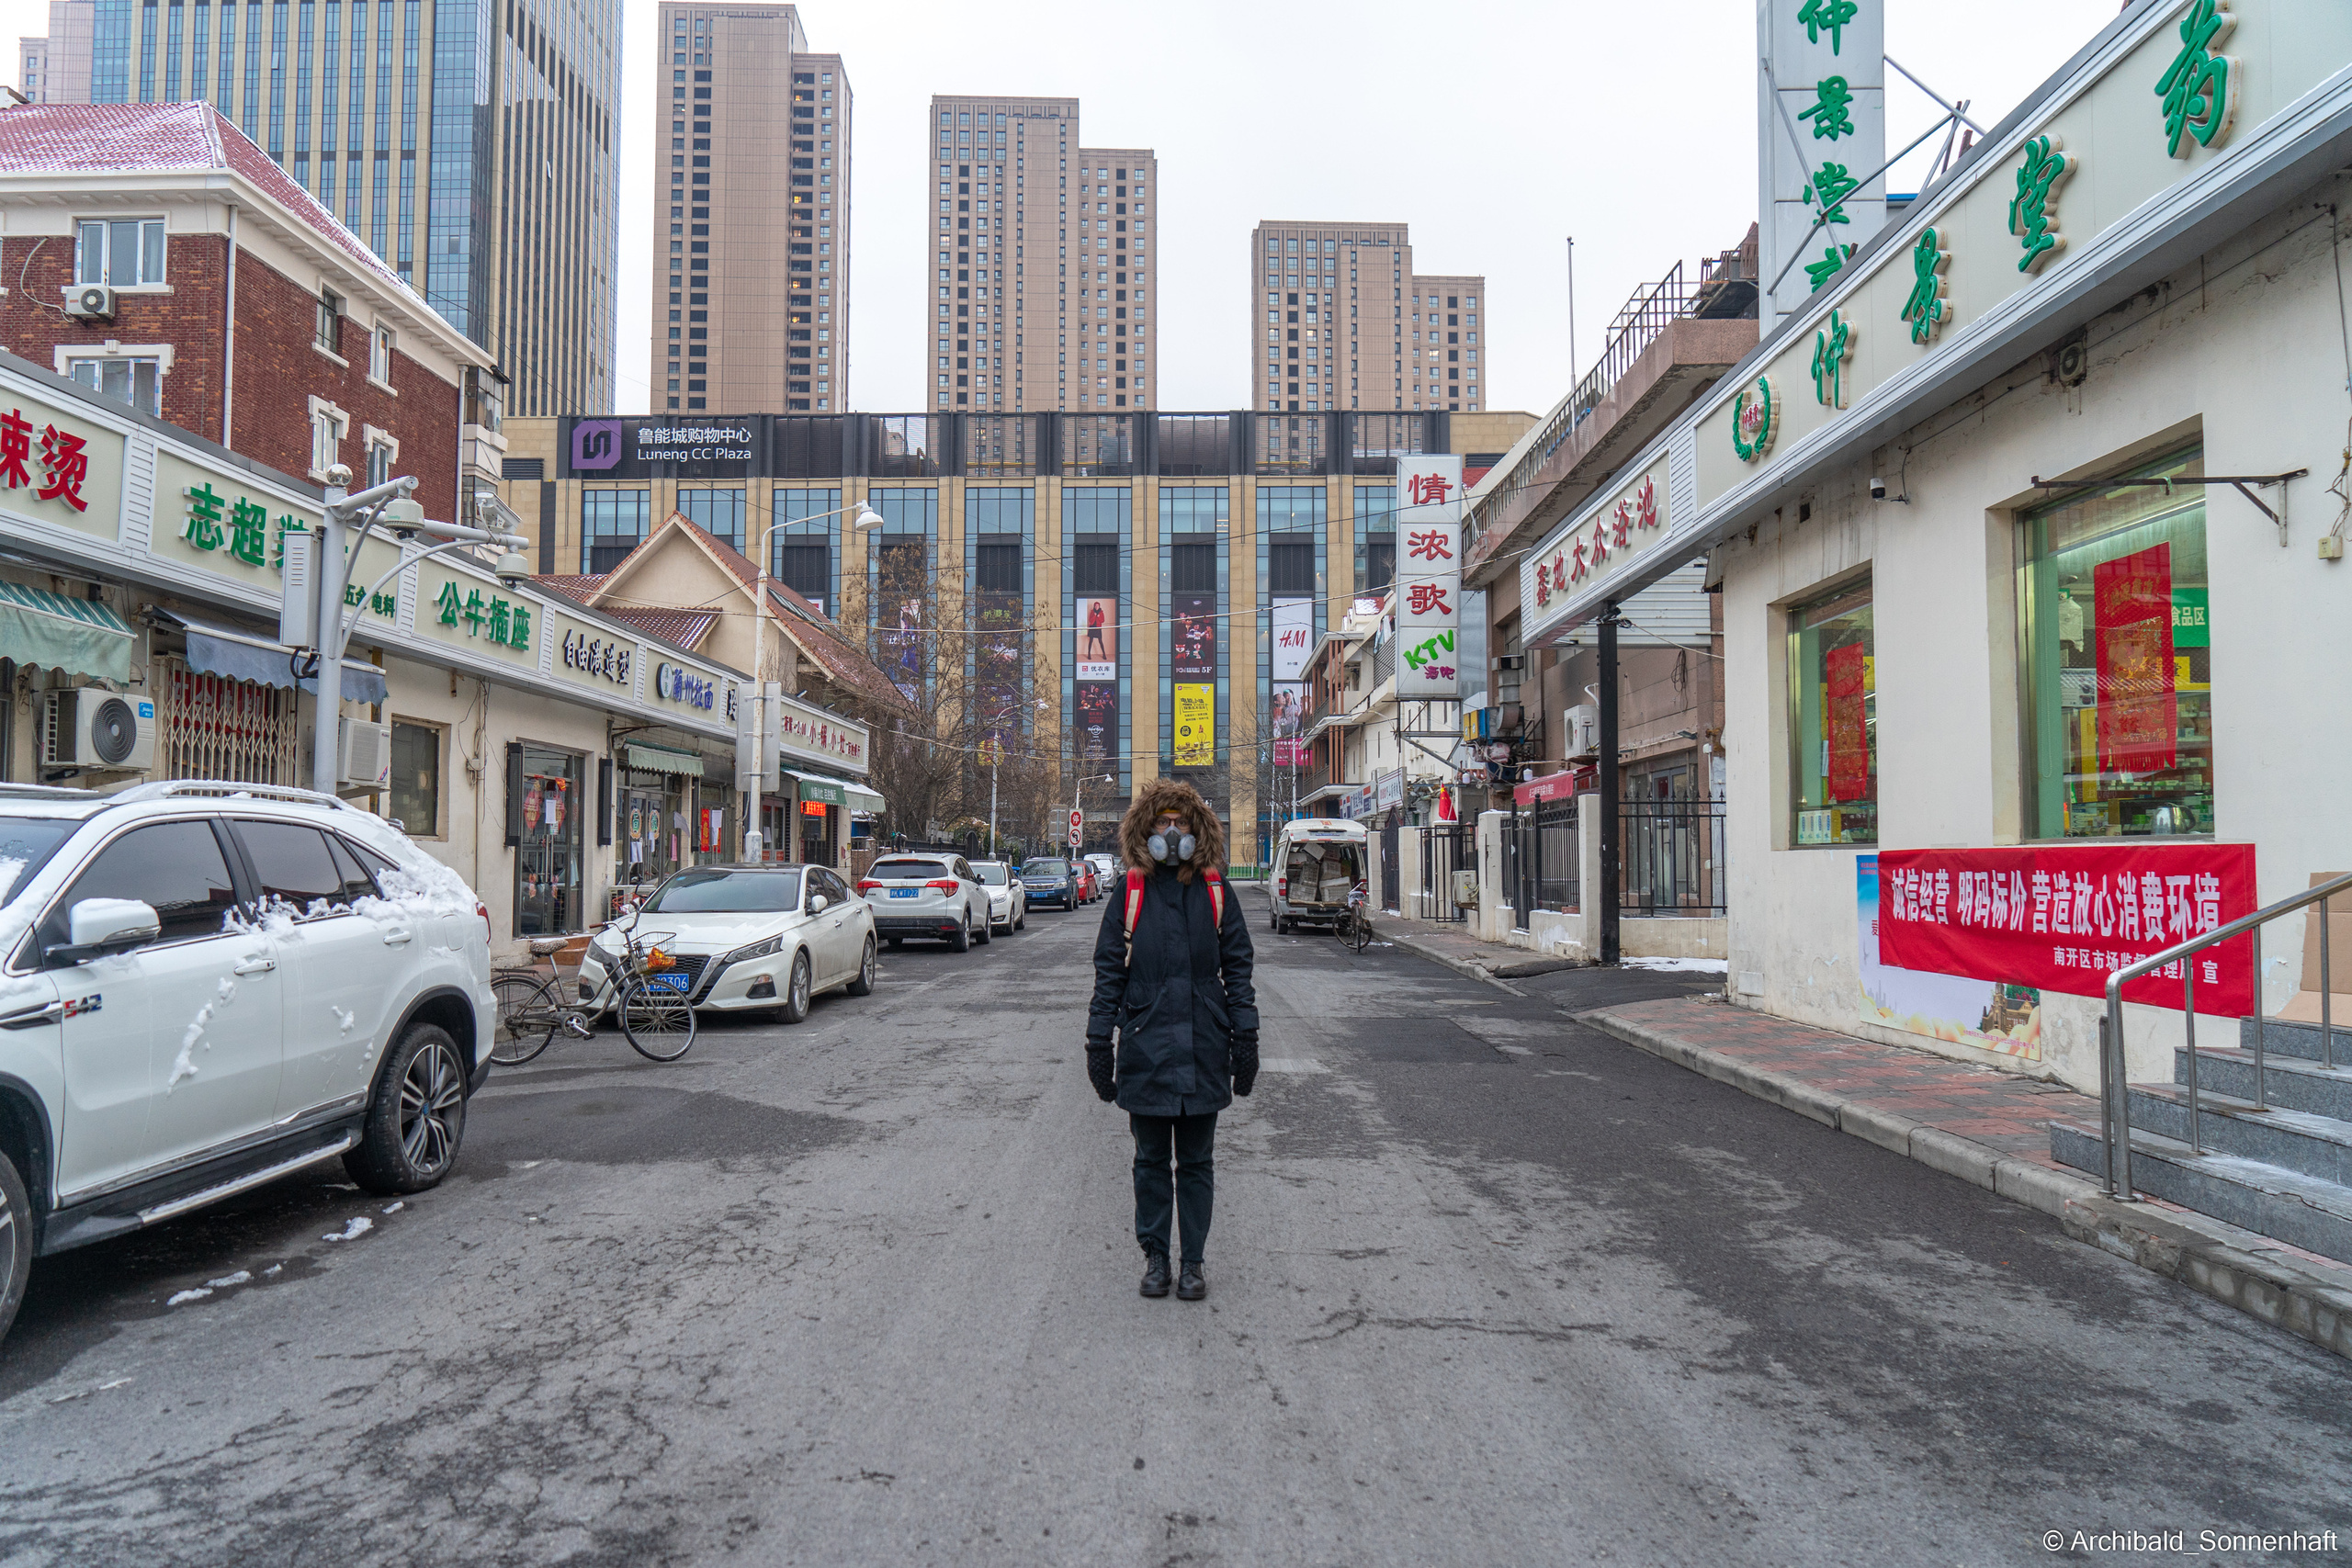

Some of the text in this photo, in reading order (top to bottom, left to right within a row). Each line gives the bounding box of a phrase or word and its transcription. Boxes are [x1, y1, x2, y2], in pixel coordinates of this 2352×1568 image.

[638, 426, 752, 445] 鲁能城购物中心
[638, 447, 752, 463] Luneng CC Plaza
[1406, 472, 1454, 616] 情浓歌
[435, 581, 532, 651] 公牛插座
[1278, 629, 1306, 649] H&M
[1402, 629, 1455, 671] KTV
[562, 628, 631, 685] 自由港造型
[1891, 867, 2222, 947] 诚信经营 明码标价 营造放心消费环境
[2201, 960, 2219, 985] 宣
[63, 993, 103, 1020] 542
